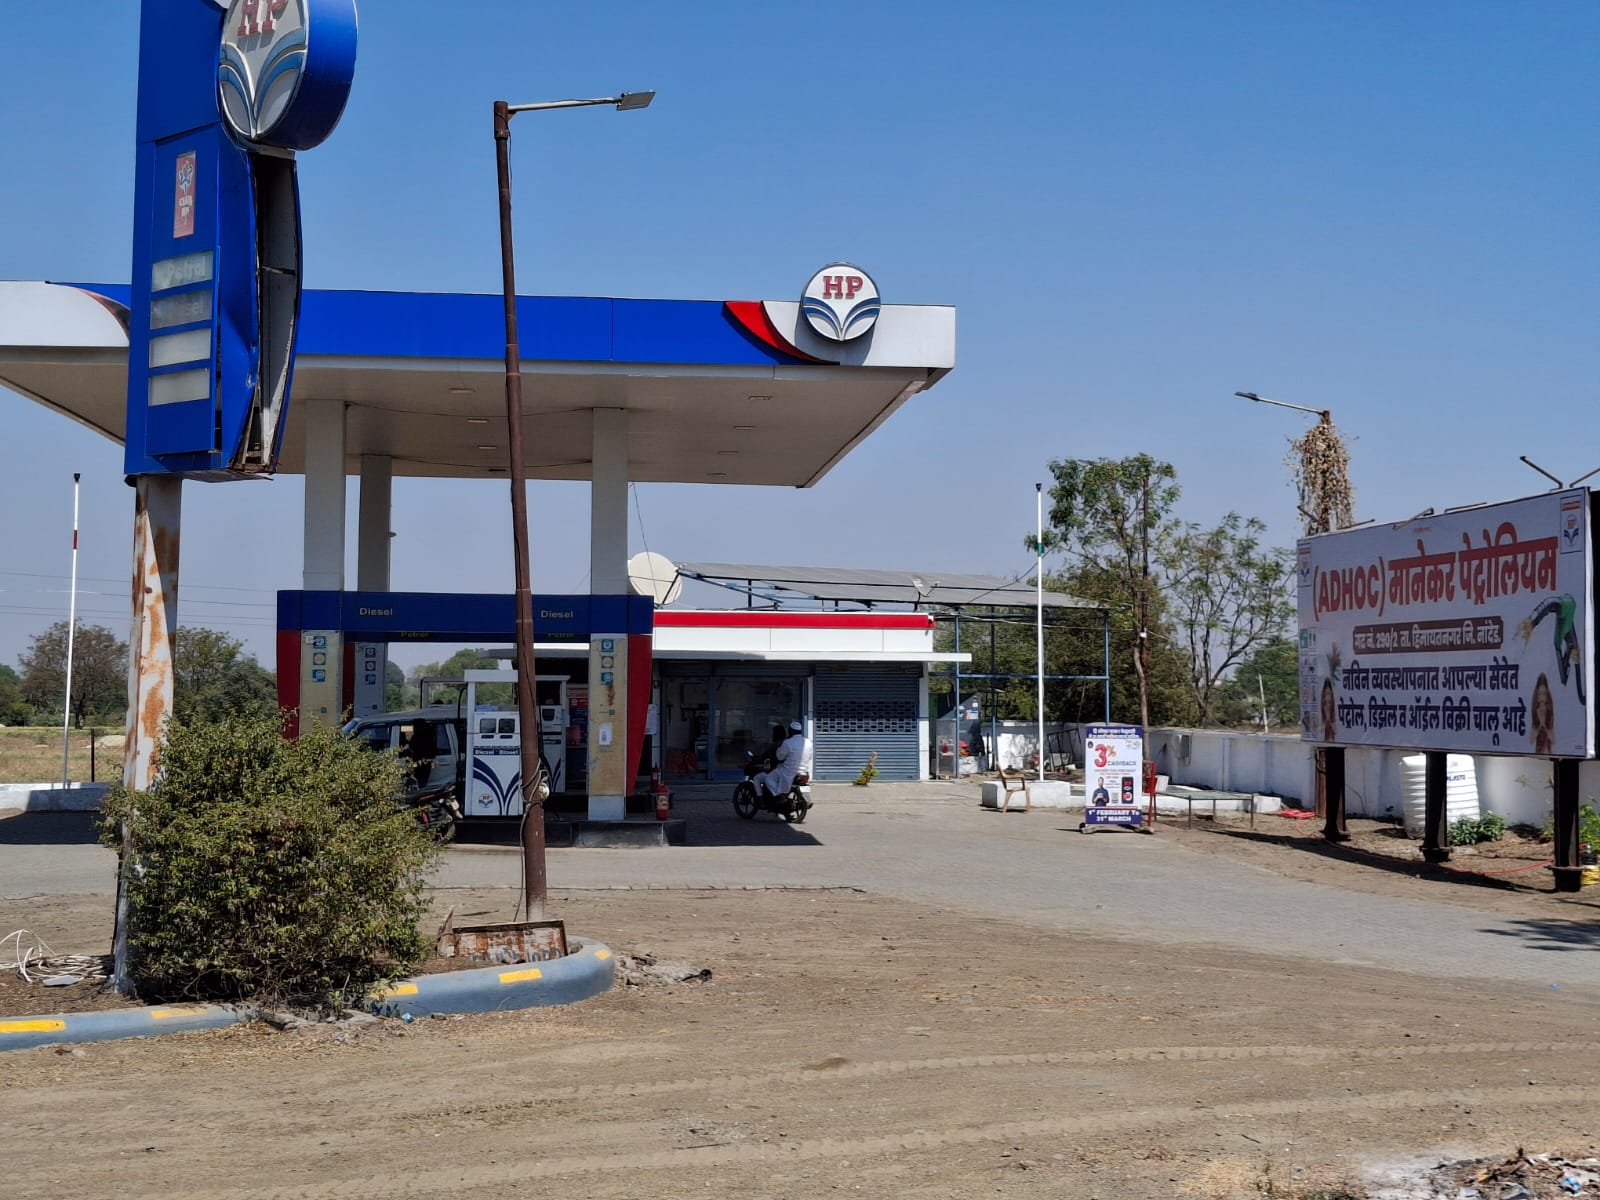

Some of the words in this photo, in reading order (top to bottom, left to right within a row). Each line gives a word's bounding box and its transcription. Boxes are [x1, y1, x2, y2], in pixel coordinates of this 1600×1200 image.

[823, 276, 863, 298] HP
[1313, 556, 1386, 622] (ADHOC)
[1388, 539, 1456, 606] मानेकर
[1458, 521, 1558, 605] पेट्रोलियम
[360, 608, 393, 616] Diesel
[541, 610, 574, 618] Diesel
[1371, 666, 1440, 691] व्यवस्थापनात
[1442, 665, 1487, 691] आपल्या
[1489, 656, 1519, 691] सेवेत
[1368, 695, 1398, 730] डिझेल
[1399, 704, 1406, 729] व
[1442, 696, 1471, 732] विक्री
[1473, 706, 1500, 746] चालू
[1502, 697, 1527, 736] आहे
